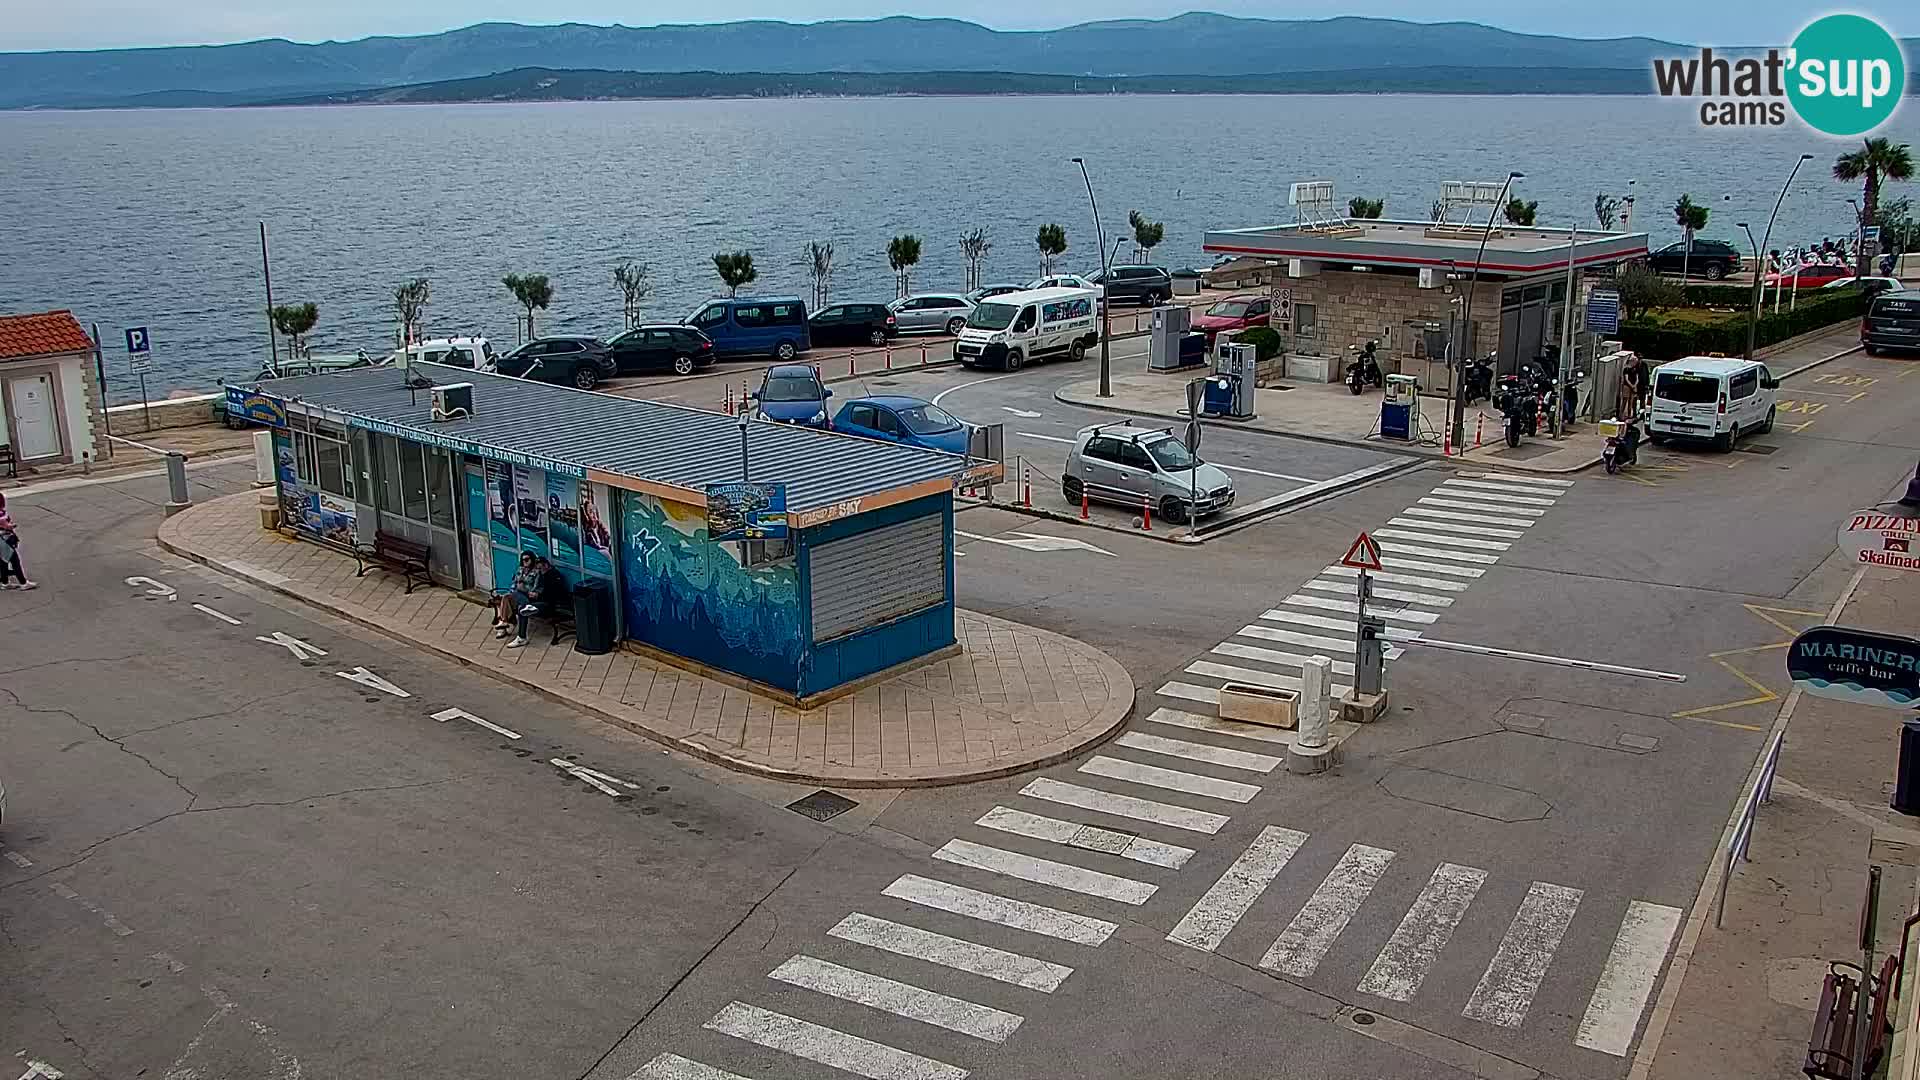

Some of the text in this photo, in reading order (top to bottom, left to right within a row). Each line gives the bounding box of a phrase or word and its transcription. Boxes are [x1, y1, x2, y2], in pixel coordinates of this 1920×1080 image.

[131, 331, 143, 349] P
[397, 427, 437, 444] AUTOBUSNA
[437, 436, 469, 452] POSTAJA
[478, 446, 494, 458] BUS
[495, 449, 526, 465] STATION
[528, 456, 554, 470] TICKET
[555, 462, 583, 477] OFFICE
[1881, 530, 1916, 541] GRILL
[1828, 662, 1896, 680] caffe bar
